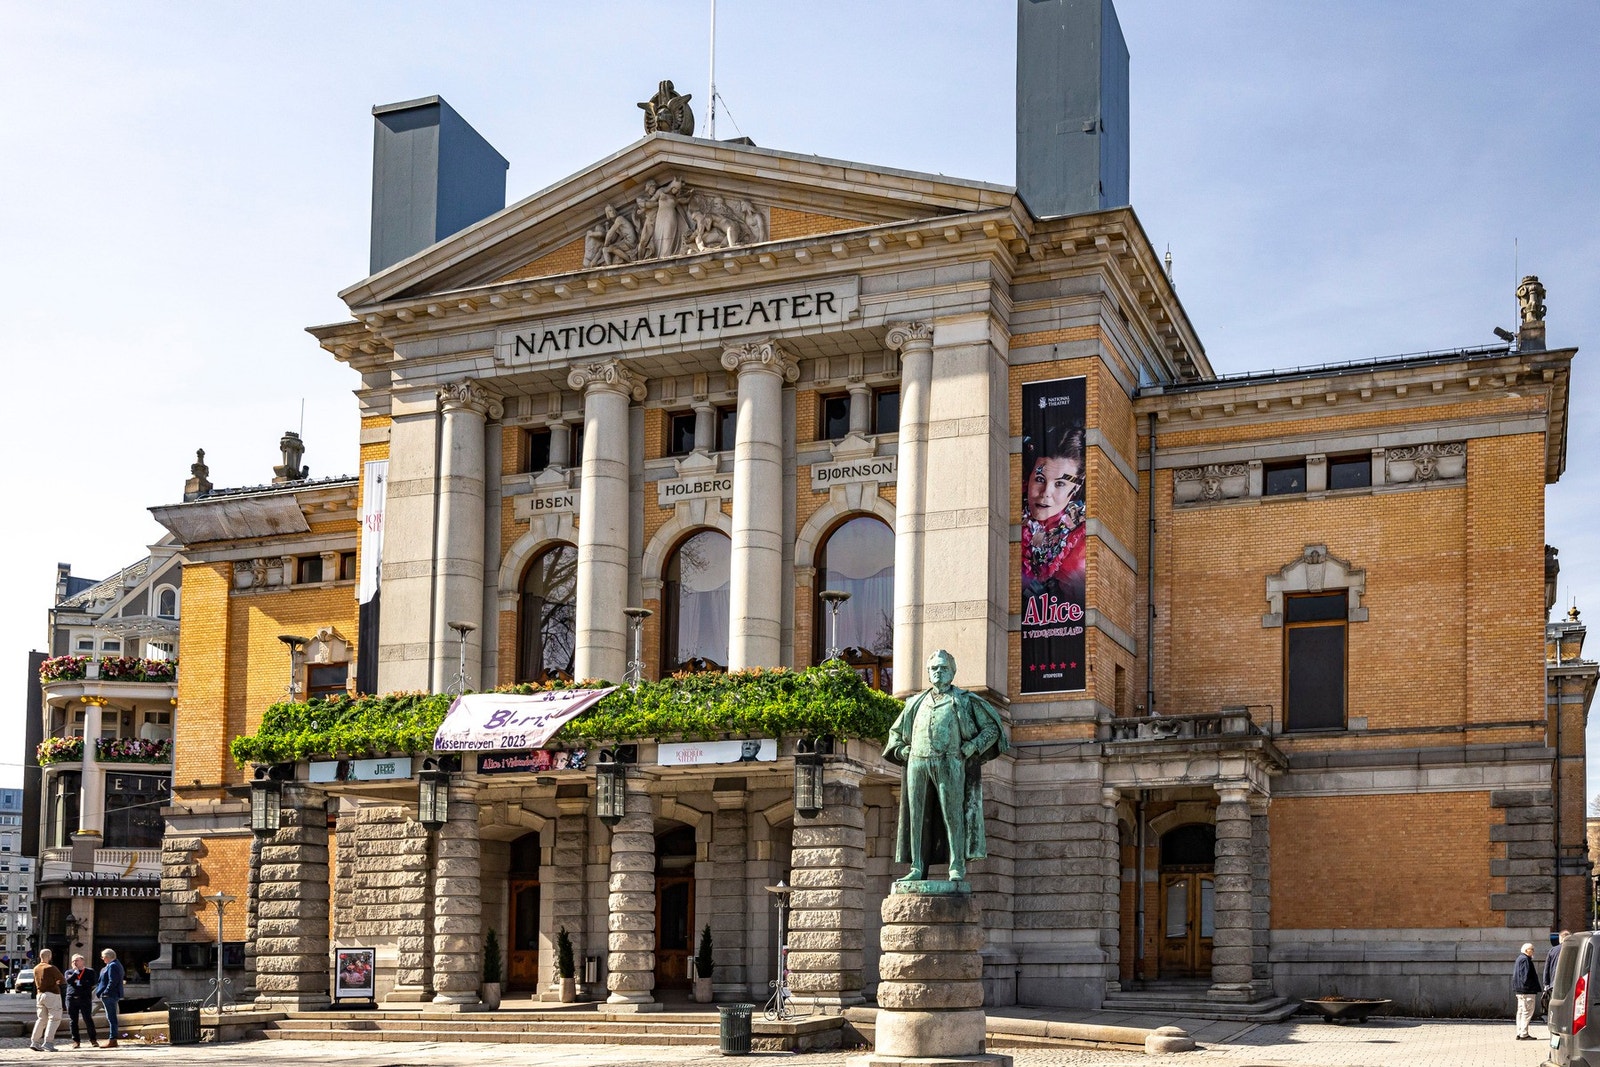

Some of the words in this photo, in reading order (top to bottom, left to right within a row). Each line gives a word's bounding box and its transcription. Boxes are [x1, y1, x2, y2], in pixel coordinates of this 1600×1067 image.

[515, 291, 837, 357] NATIONALTHEATER
[818, 462, 893, 482] BJØRNSON
[666, 480, 731, 496] HOLBERG
[531, 496, 573, 510] IBSEN
[1022, 593, 1084, 625] Alice
[435, 738, 494, 750] Nissenrevyen
[501, 734, 526, 748] 2023
[115, 779, 167, 791] EIK
